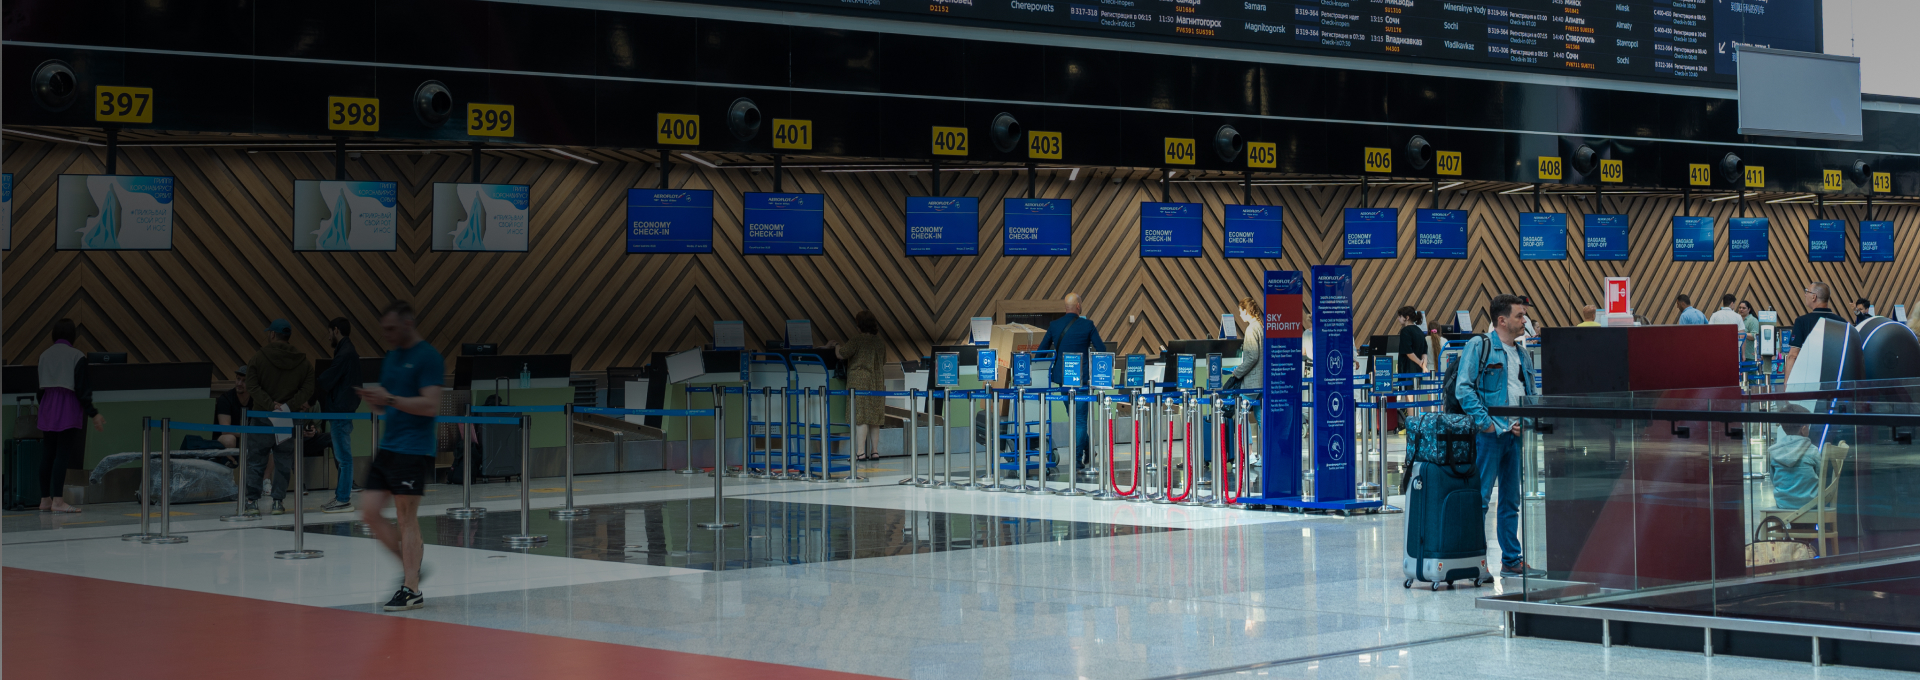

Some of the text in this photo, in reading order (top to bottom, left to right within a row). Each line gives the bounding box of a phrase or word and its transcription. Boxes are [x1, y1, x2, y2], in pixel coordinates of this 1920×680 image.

[930, 5, 949, 13] D2152
[1010, 0, 1054, 13] Cherepovets
[1075, 8, 1098, 17] 317-318
[1244, 2, 1267, 11] Samara
[1159, 15, 1174, 23] 11:30
[1176, 15, 1222, 28] Магнитогорск
[1385, 15, 1400, 25] Сочи
[1244, 22, 1286, 34] Magnitogorsk
[1444, 22, 1458, 30] Sochi
[1386, 35, 1422, 47] Владикавказ
[1565, 33, 1595, 44] Ставрополь
[1566, 50, 1579, 61] Сочи
[1616, 56, 1630, 65] Sochi
[100, 92, 150, 118] 397
[332, 102, 377, 126] 398
[471, 109, 512, 132] 399
[660, 119, 698, 141] 400
[775, 124, 808, 145] 401
[935, 132, 966, 151] 402
[1031, 136, 1060, 155] 403
[1167, 142, 1194, 161] 404
[1249, 146, 1275, 164] 405
[1367, 152, 1390, 169] 406
[1438, 155, 1460, 172] 407
[1540, 161, 1560, 176] 408
[1602, 164, 1622, 180] 409
[1691, 167, 1709, 182] 410
[1746, 169, 1763, 184] 411
[1824, 173, 1841, 187] 412
[1874, 175, 1890, 189] 413
[633, 221, 671, 229] ECONOMY
[749, 223, 785, 231] ECONOMY
[633, 228, 670, 236] CHECK-IN
[749, 230, 784, 238] CHECK-IN
[911, 232, 942, 240] CHECK-IN
[1266, 313, 1282, 322] SKY
[1266, 322, 1301, 331] PRIORITY
